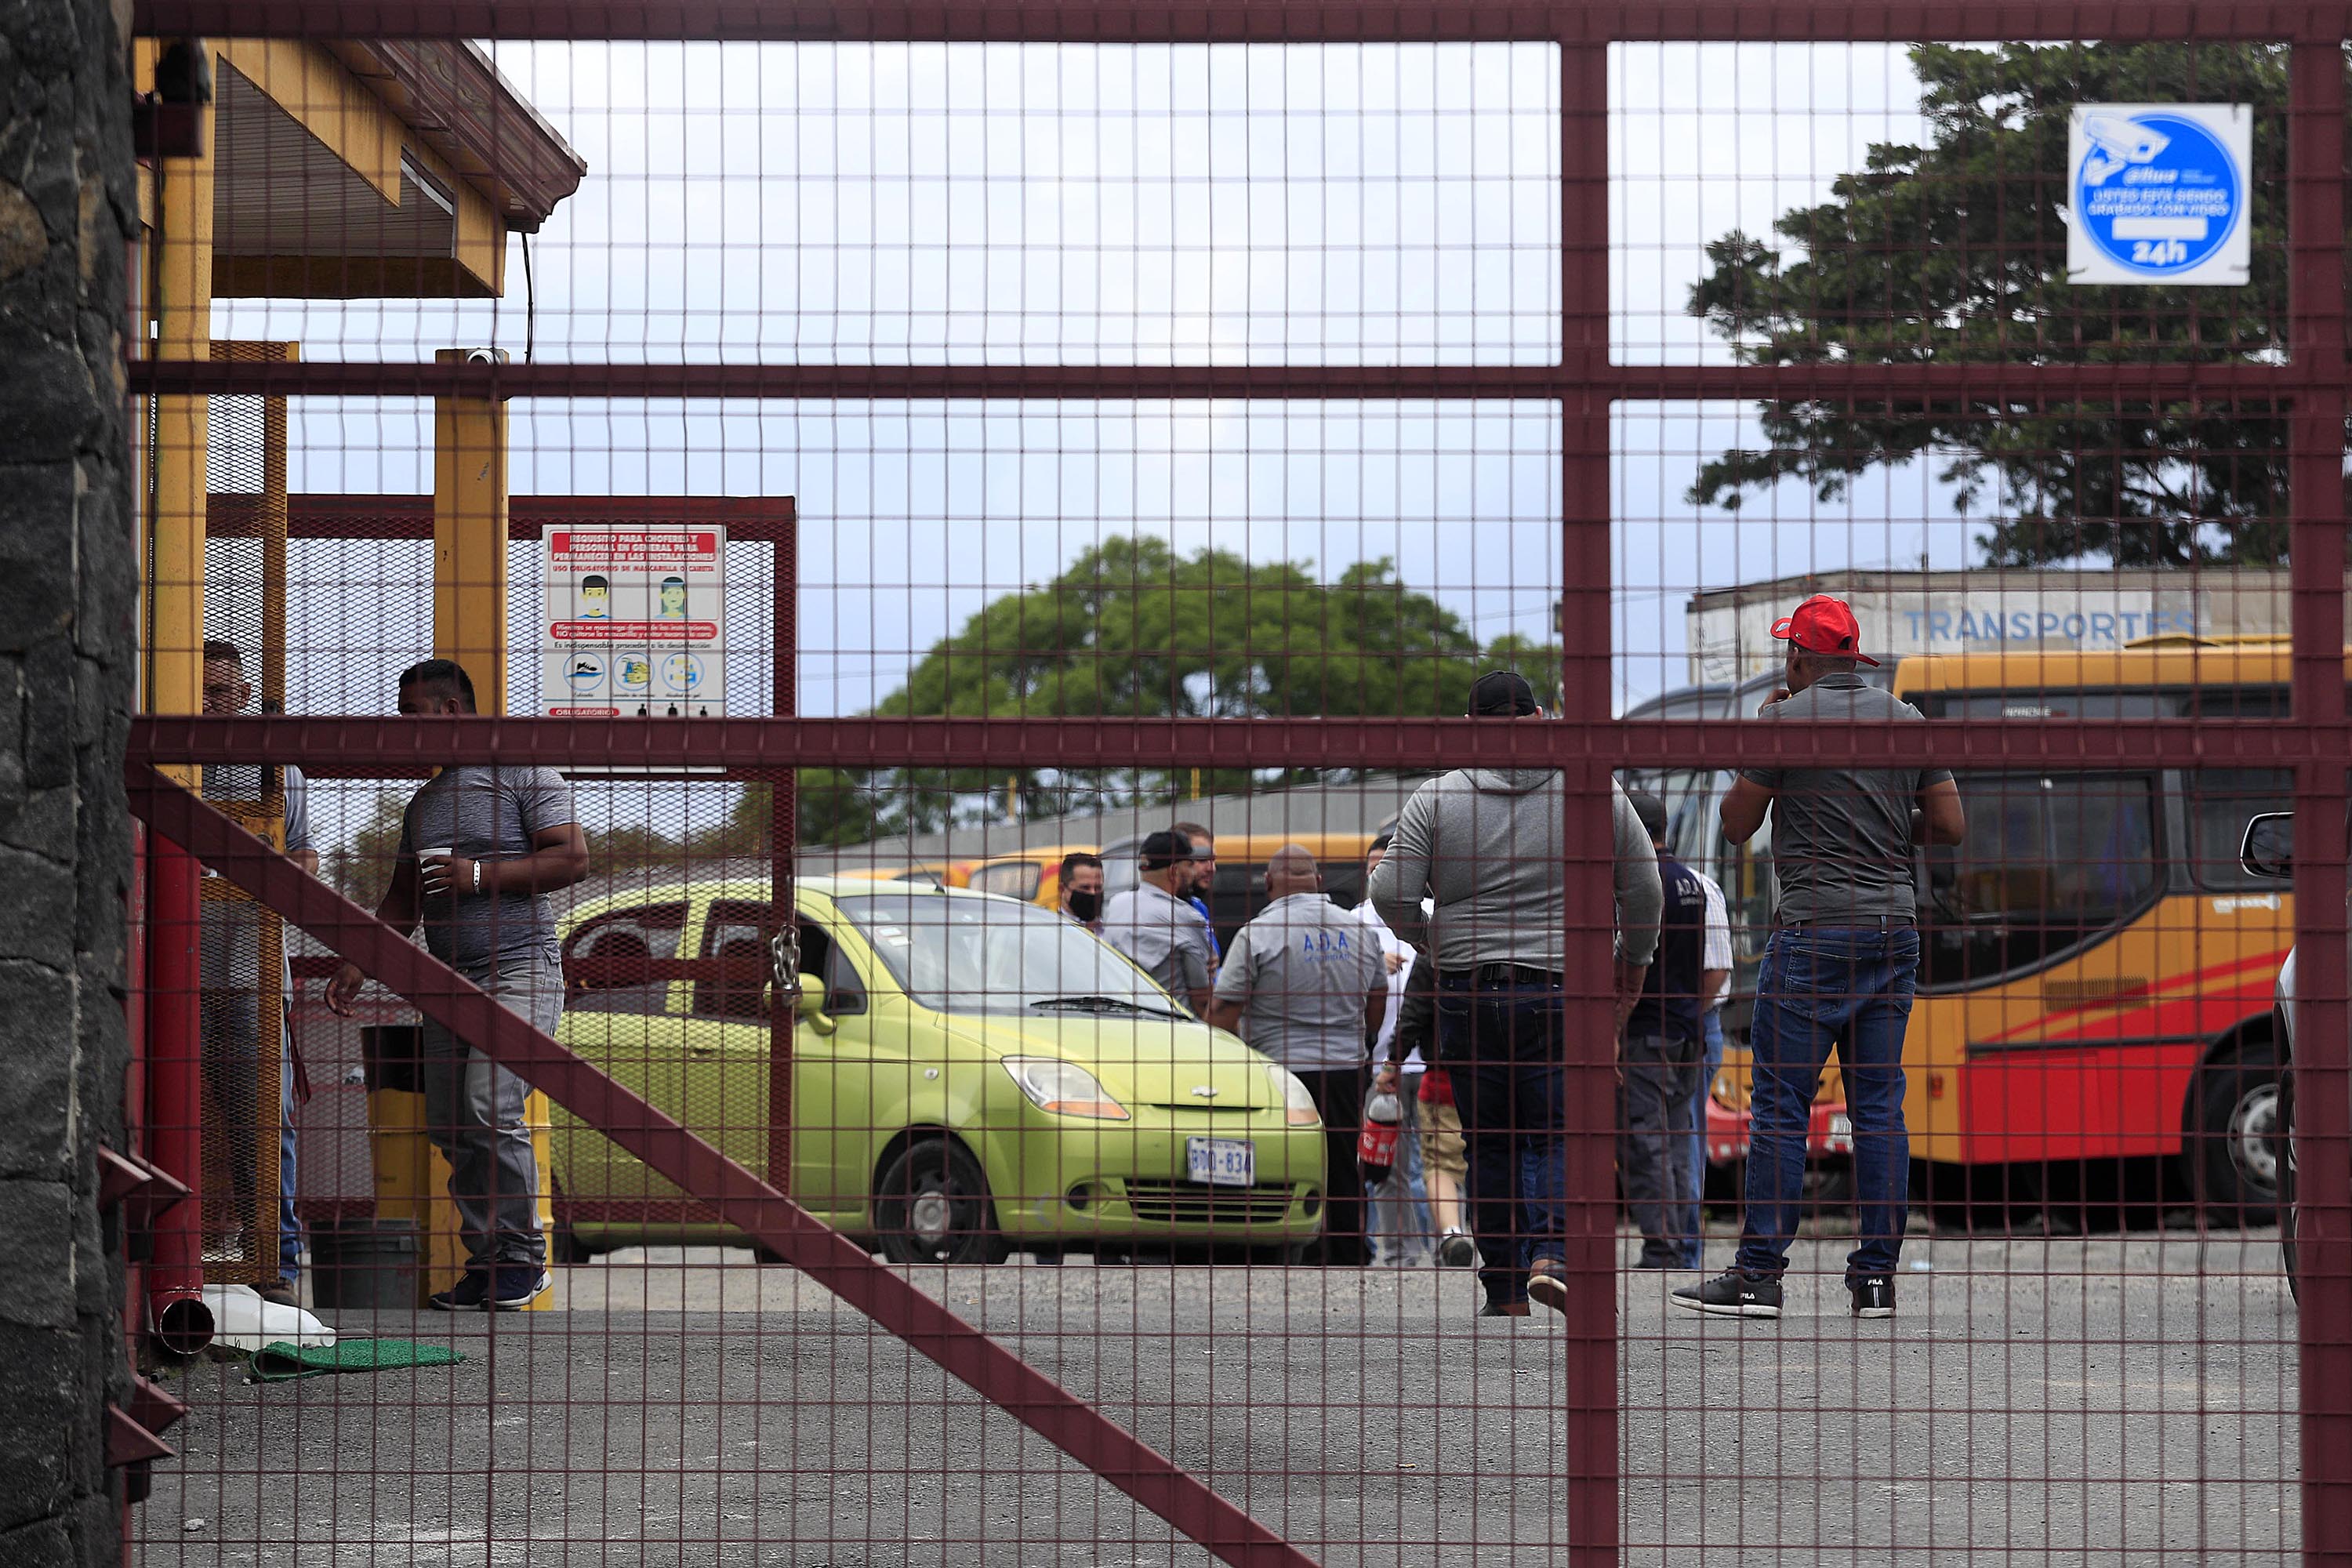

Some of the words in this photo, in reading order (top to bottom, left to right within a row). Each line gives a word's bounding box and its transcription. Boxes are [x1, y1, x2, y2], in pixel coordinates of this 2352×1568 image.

[2093, 189, 2139, 202] USTED
[2175, 189, 2226, 203] SIENDO
[2089, 203, 2151, 216] GRABADO
[2156, 203, 2185, 216] CON
[2188, 204, 2228, 216] VIDEO
[2132, 238, 2187, 267] 24h
[569, 534, 616, 543] REQUISITO
[619, 534, 643, 543] PARA
[645, 534, 689, 543] CHOFERES
[691, 534, 699, 543] Y
[569, 543, 616, 552] PERSONAL
[617, 543, 630, 552] EN
[632, 543, 672, 552] GENERAL
[673, 543, 699, 552] PARA
[554, 552, 612, 561] PERMANECER
[614, 552, 626, 561] EN
[628, 552, 644, 561] LAS
[646, 552, 714, 561] INSTALACIONES
[1903, 610, 2194, 641] TRANSPORTES
